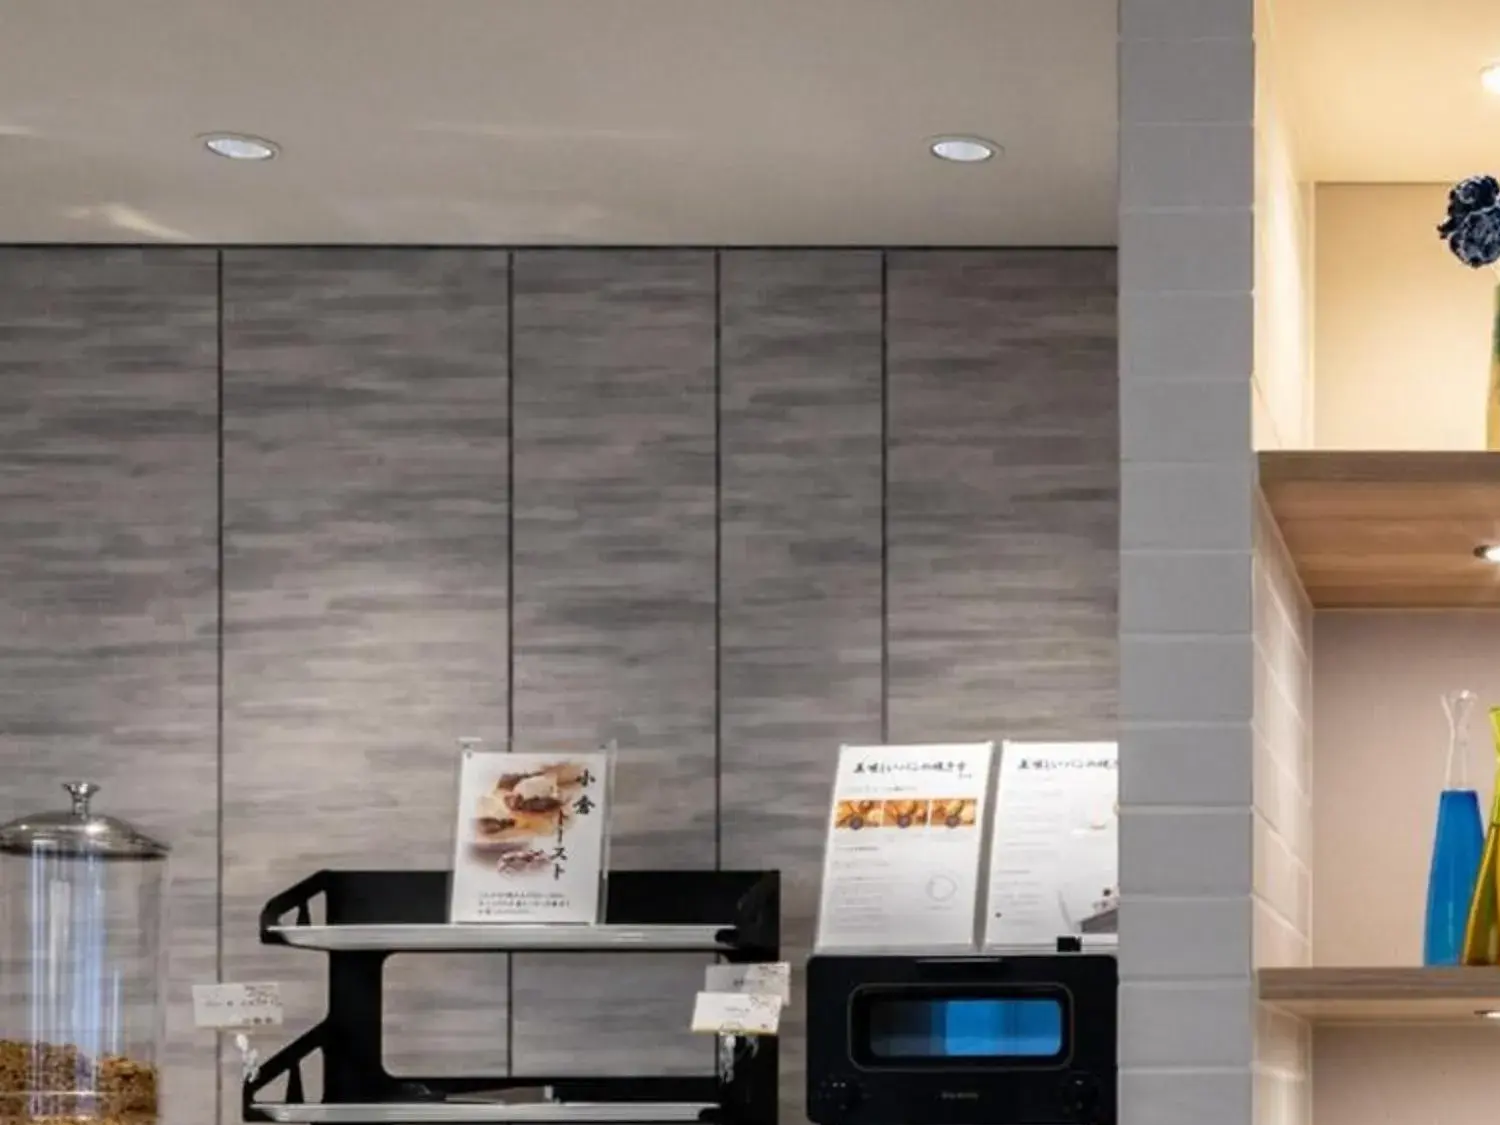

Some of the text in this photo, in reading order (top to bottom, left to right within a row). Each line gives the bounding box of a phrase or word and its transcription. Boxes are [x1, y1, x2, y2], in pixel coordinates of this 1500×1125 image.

[573, 769, 596, 815] 小倉
[549, 808, 569, 881] トースト
